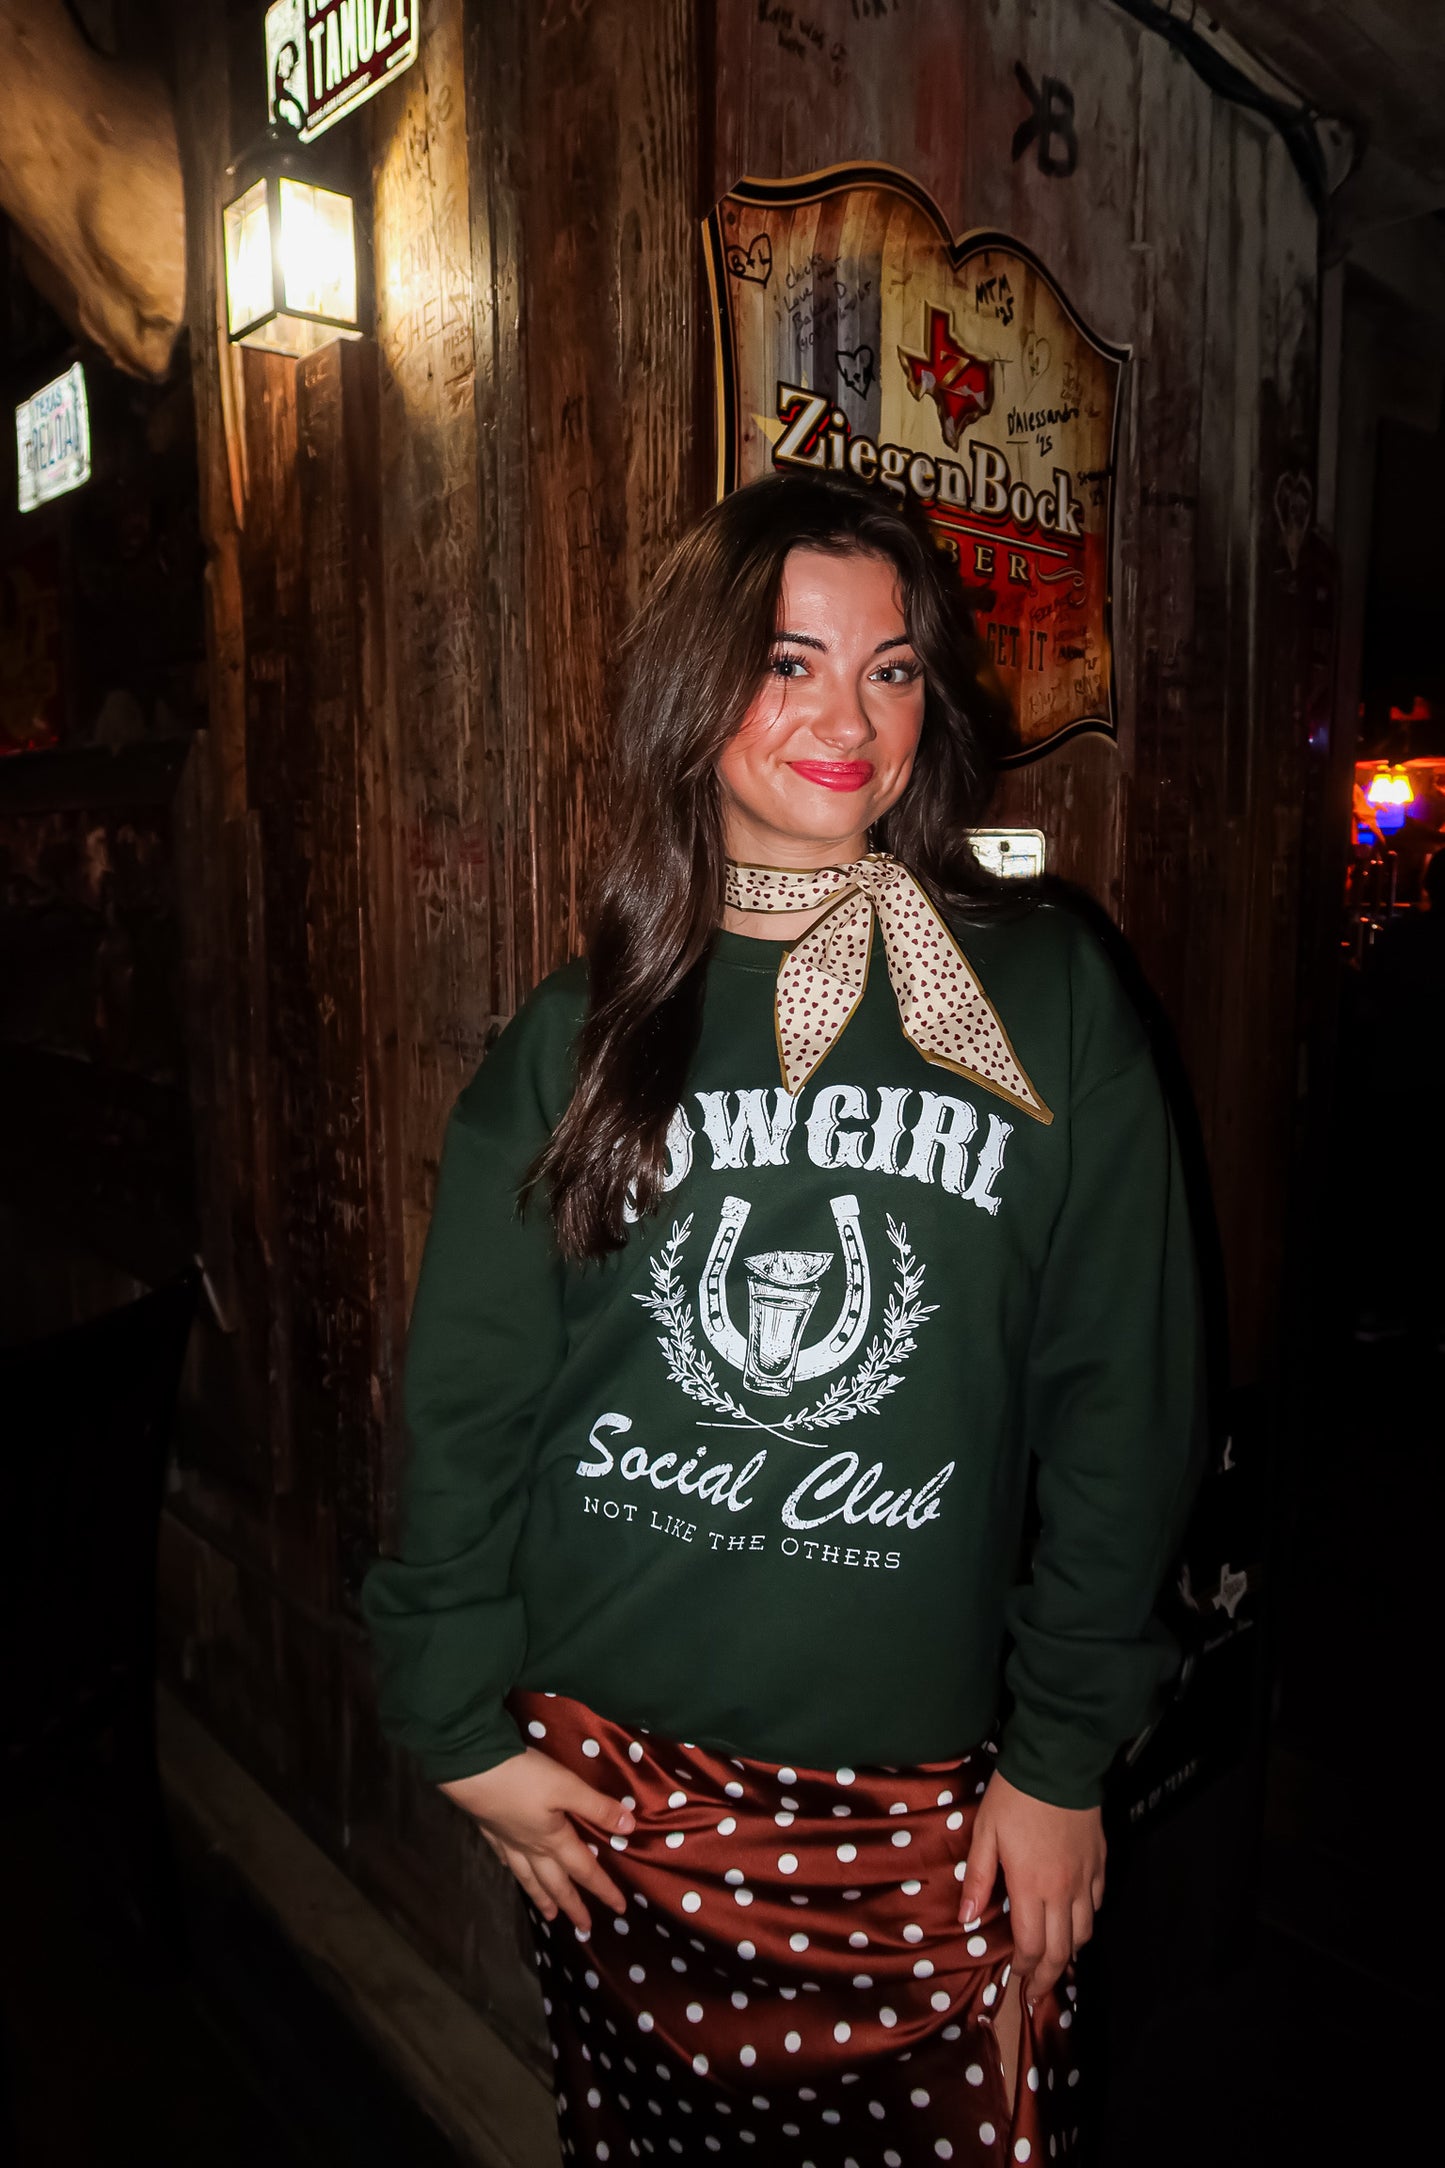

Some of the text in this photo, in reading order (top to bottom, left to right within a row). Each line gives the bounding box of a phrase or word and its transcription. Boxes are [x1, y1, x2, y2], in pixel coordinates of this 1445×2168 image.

[772, 382, 1084, 539] ZiegenBock
[985, 622, 1048, 672] GET IT
[622, 1084, 1015, 1224] OWGIRL
[576, 1412, 956, 1531] Social Club
[584, 1496, 902, 1570] NOT LIKE THE OTHERS
